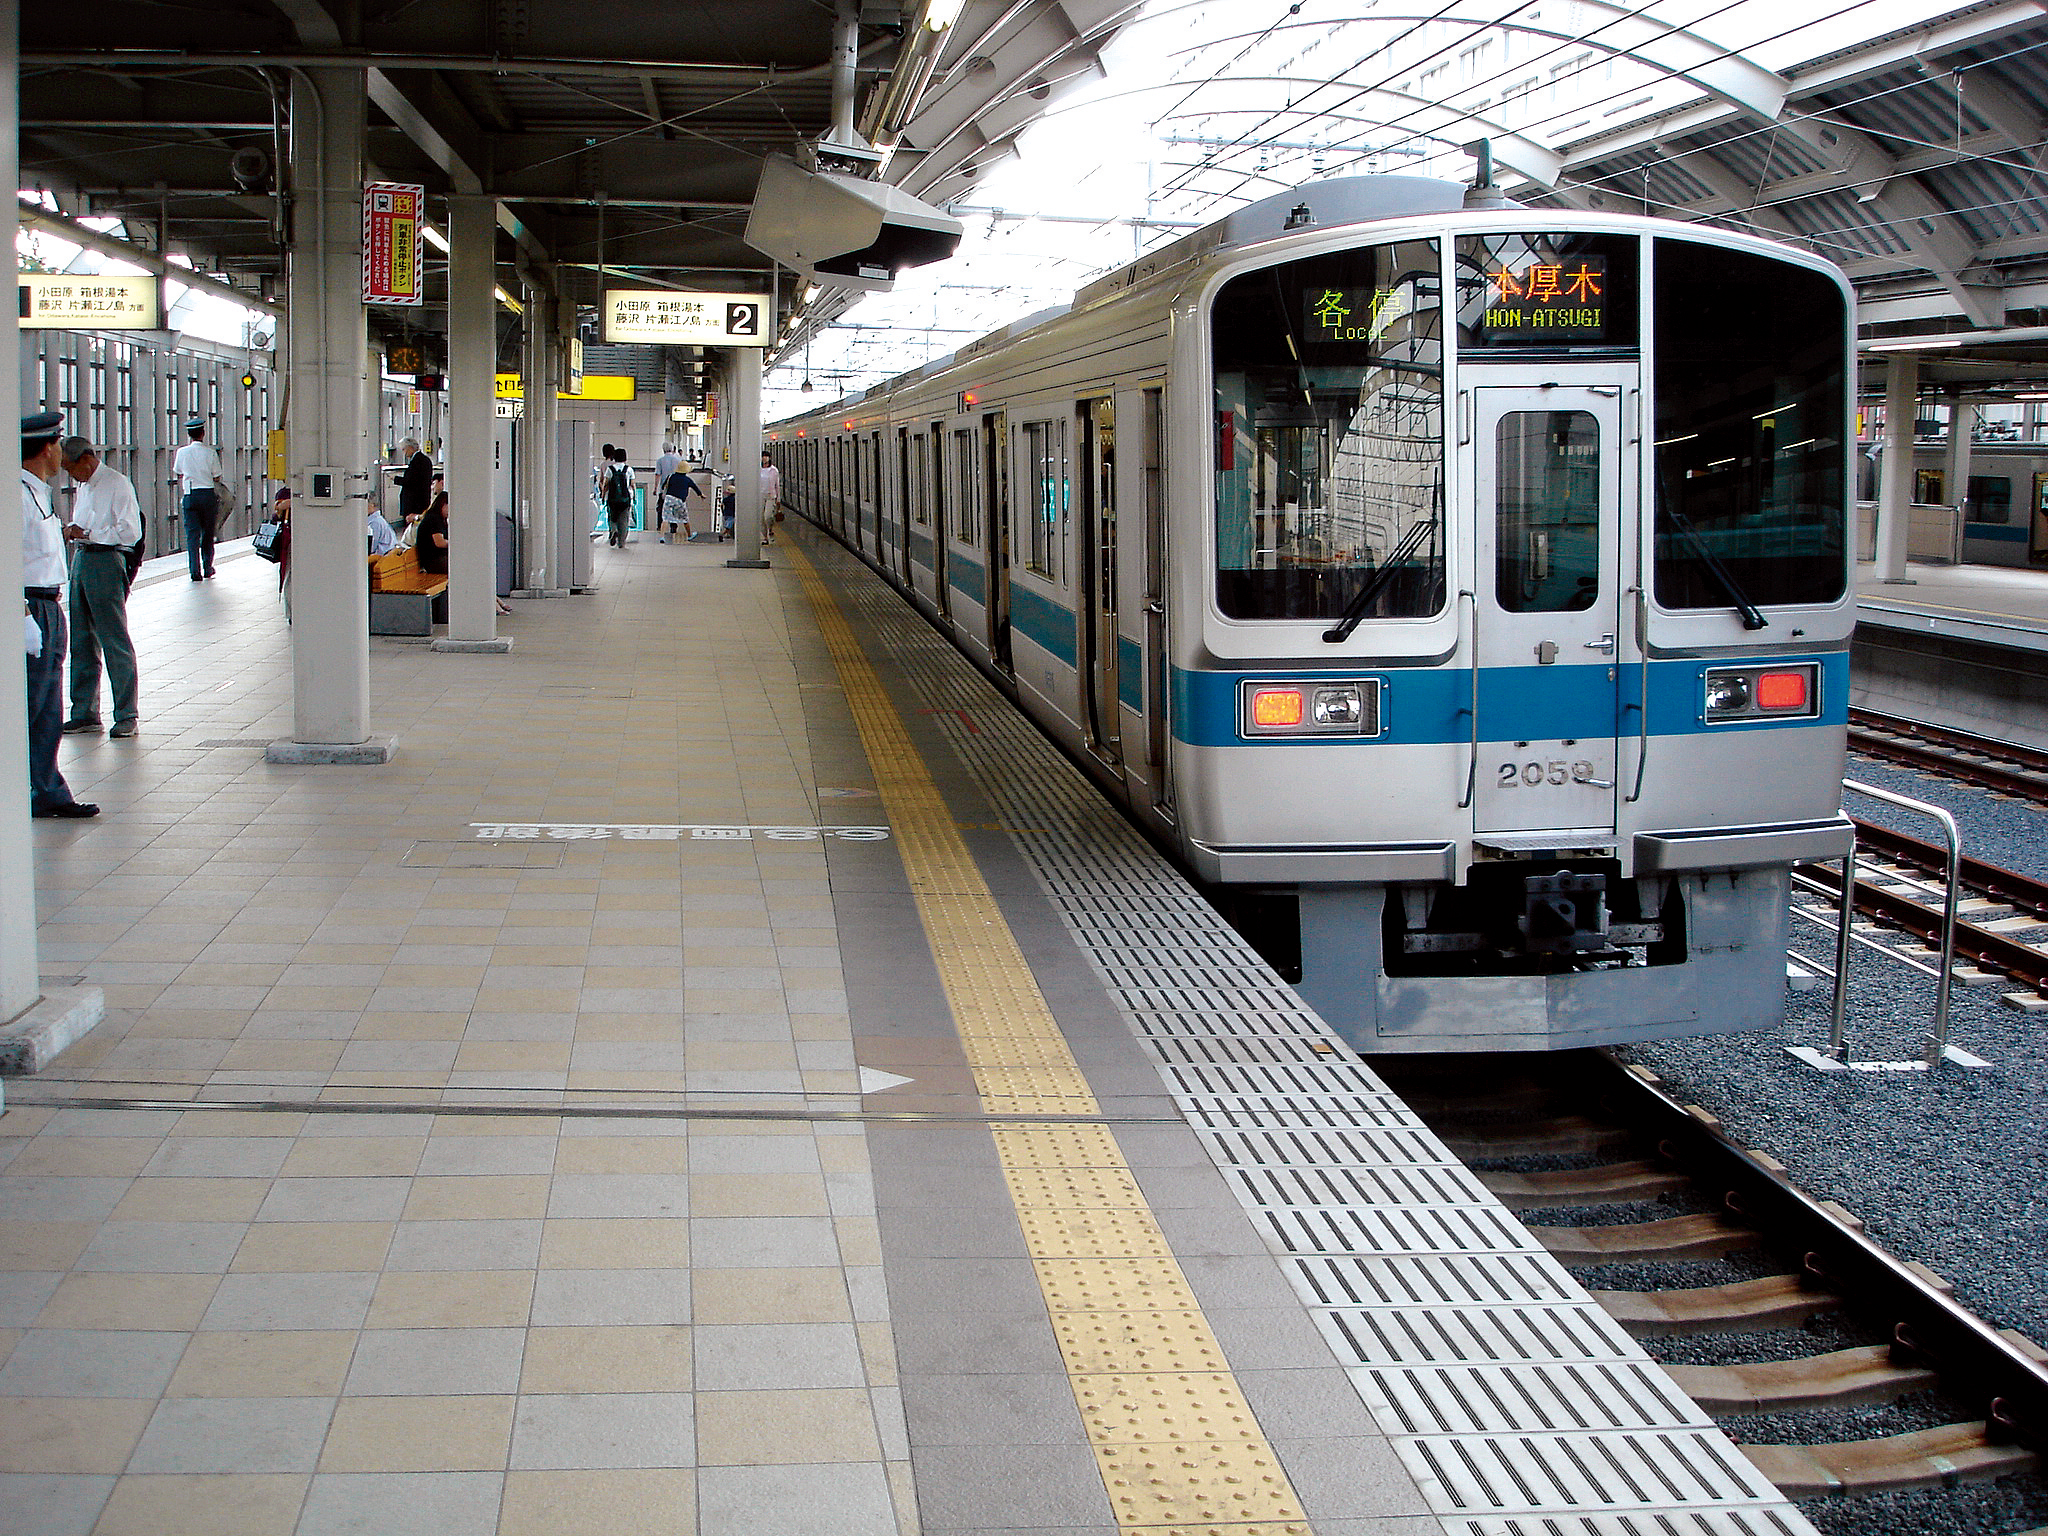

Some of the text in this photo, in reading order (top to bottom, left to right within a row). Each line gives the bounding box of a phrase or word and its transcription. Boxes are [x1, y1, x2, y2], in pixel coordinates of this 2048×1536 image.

[1486, 264, 1602, 303] 本厚木
[38, 287, 129, 298] 小田原 箱根湯本
[38, 300, 62, 311] 藤沢
[69, 300, 125, 311] 片瀬江ノ島
[615, 300, 650, 312] 小田原
[1314, 288, 1405, 328] 各停
[615, 313, 640, 324] 藤沢
[731, 304, 752, 333] 2
[1486, 309, 1601, 328] HON-ATSUGI
[1334, 328, 1388, 340] LOCAL
[1496, 760, 1594, 788] 2059
